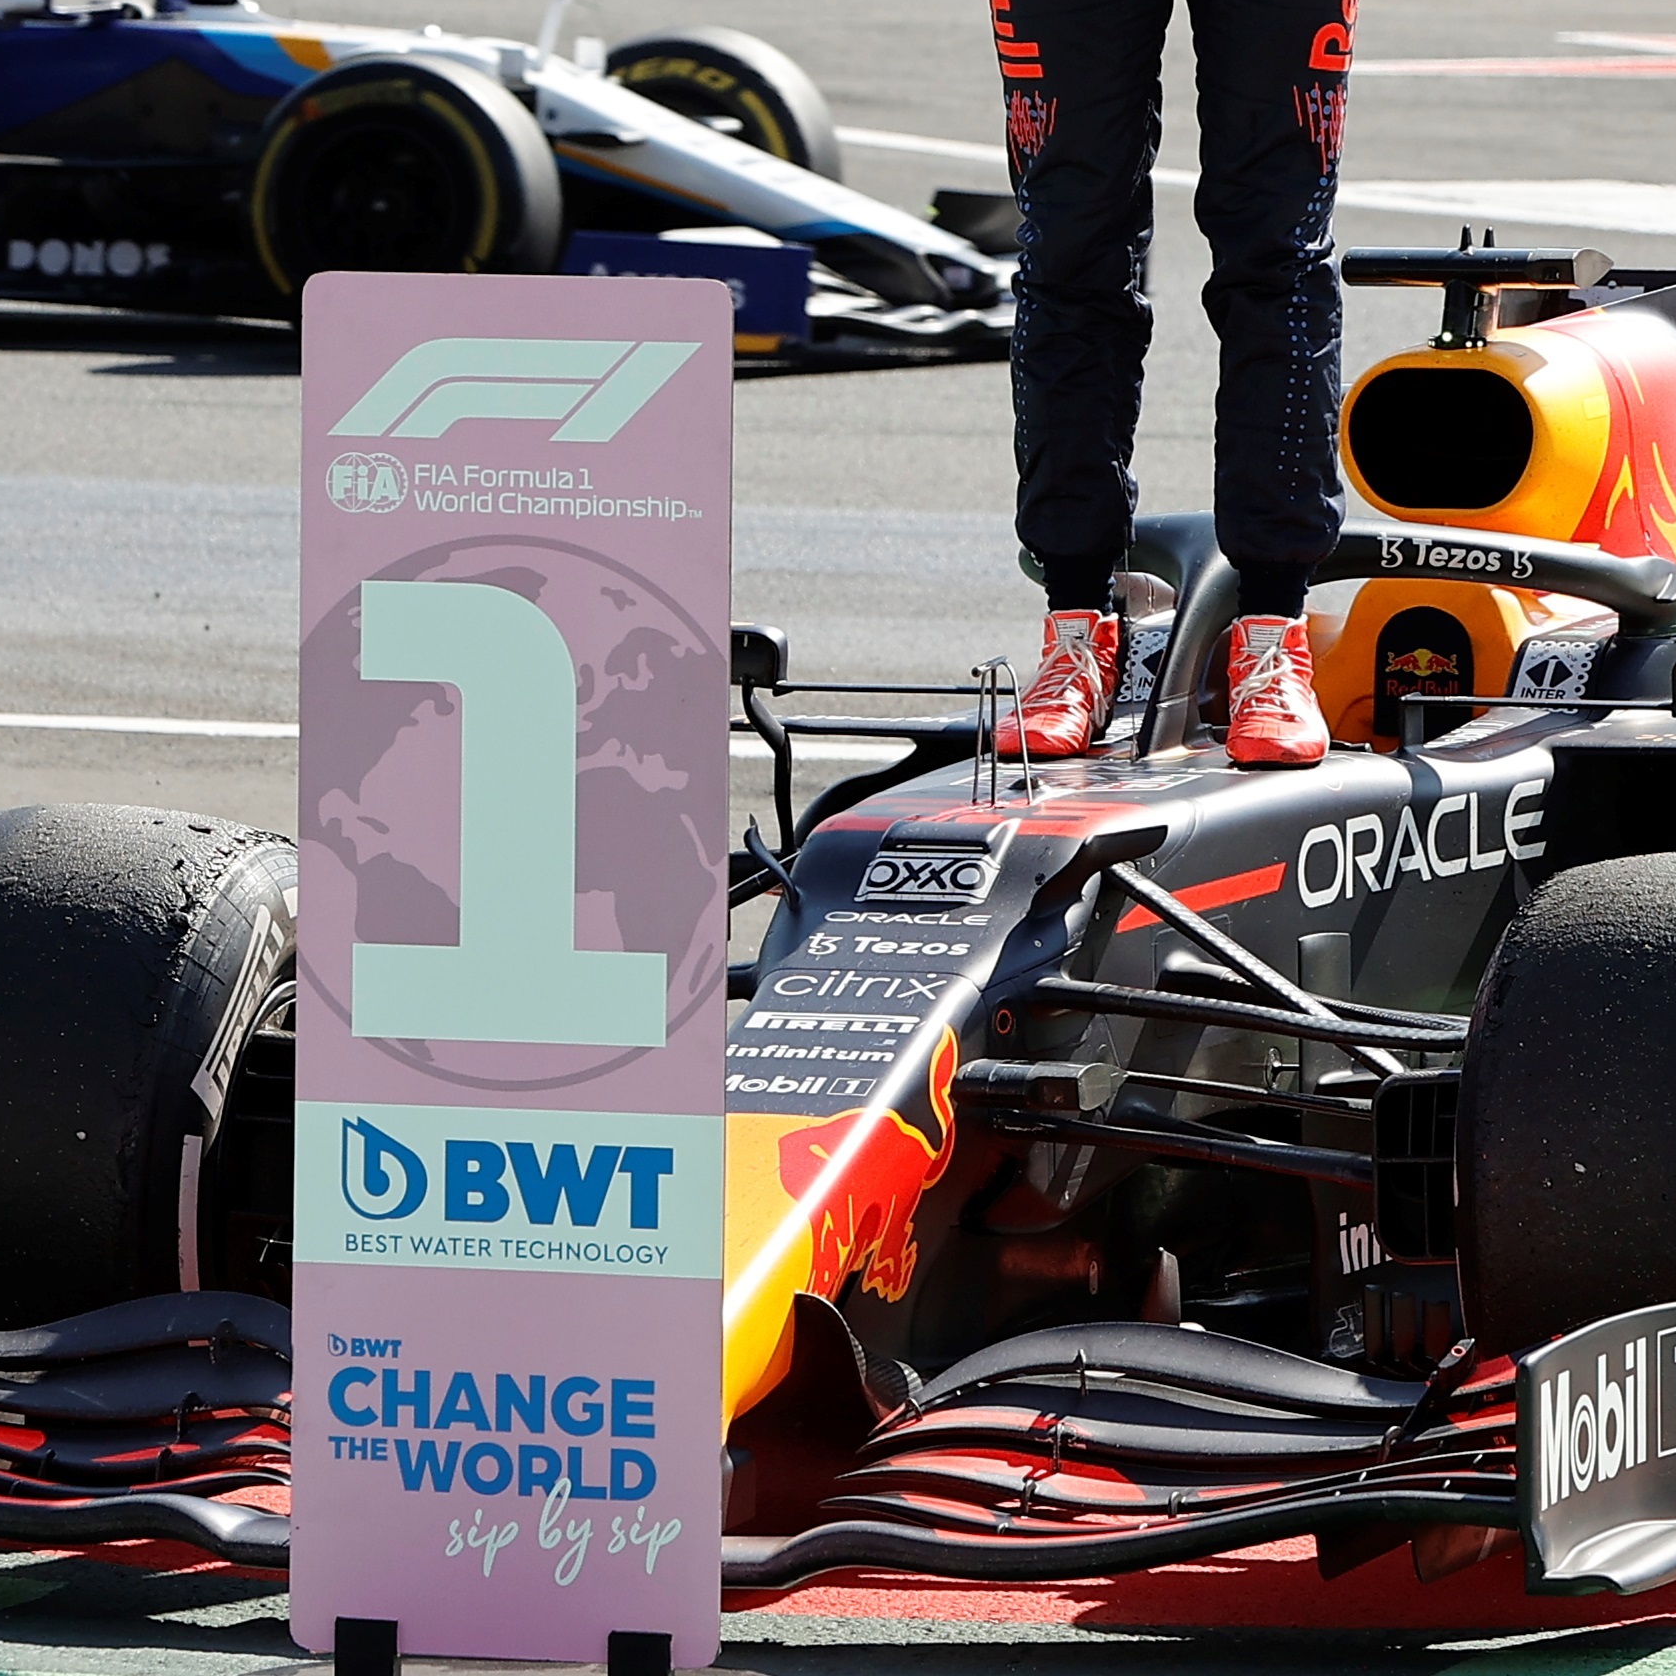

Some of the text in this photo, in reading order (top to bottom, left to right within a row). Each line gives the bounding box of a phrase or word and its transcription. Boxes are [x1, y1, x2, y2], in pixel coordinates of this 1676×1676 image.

[326, 337, 703, 443] F1
[414, 463, 594, 490] FIA Formula 1
[413, 490, 493, 514] World
[1412, 538, 1502, 573] Tezos
[1519, 686, 1567, 700] INTER
[352, 579, 667, 1048] 1
[1296, 778, 1548, 909] ORACLE
[865, 859, 986, 890] OXXO
[824, 910, 993, 927] ORACLE
[853, 936, 972, 956] Tezos
[773, 970, 948, 1001] citrix
[744, 1011, 922, 1034] PIRELLI
[725, 1044, 895, 1063] infinitum
[444, 1138, 675, 1230] BWT
[344, 1232, 669, 1265] BEST WATER TECHNOLOGY
[350, 1337, 402, 1359] BWT
[327, 1365, 656, 1439] CHANGE
[1539, 1336, 1648, 1513] Mobil
[328, 1434, 657, 1502] THE WORLD
[445, 1477, 682, 1587] sip by sip
